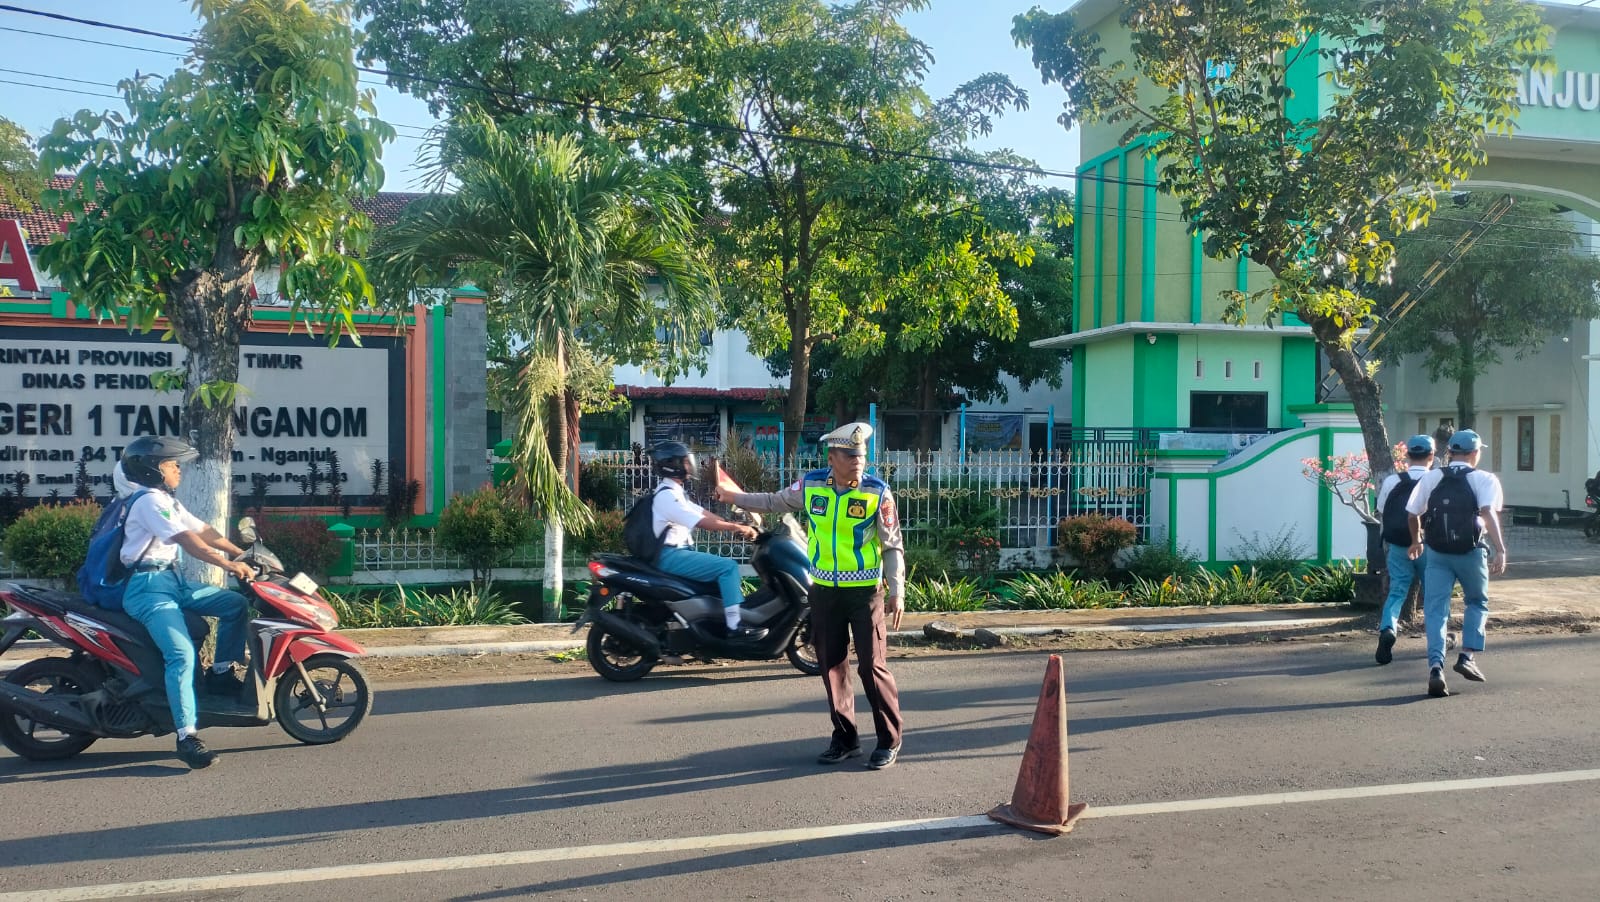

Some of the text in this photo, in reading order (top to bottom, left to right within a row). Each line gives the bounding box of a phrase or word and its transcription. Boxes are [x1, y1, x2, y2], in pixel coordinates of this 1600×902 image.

[78, 349, 173, 367] PROVINSI
[244, 353, 304, 370] TIMUR
[22, 373, 86, 389] DINAS
[0, 404, 368, 437] GERI 1 TANNGANOM
[82, 445, 107, 462] 84
[261, 447, 337, 466] Nganjuk
